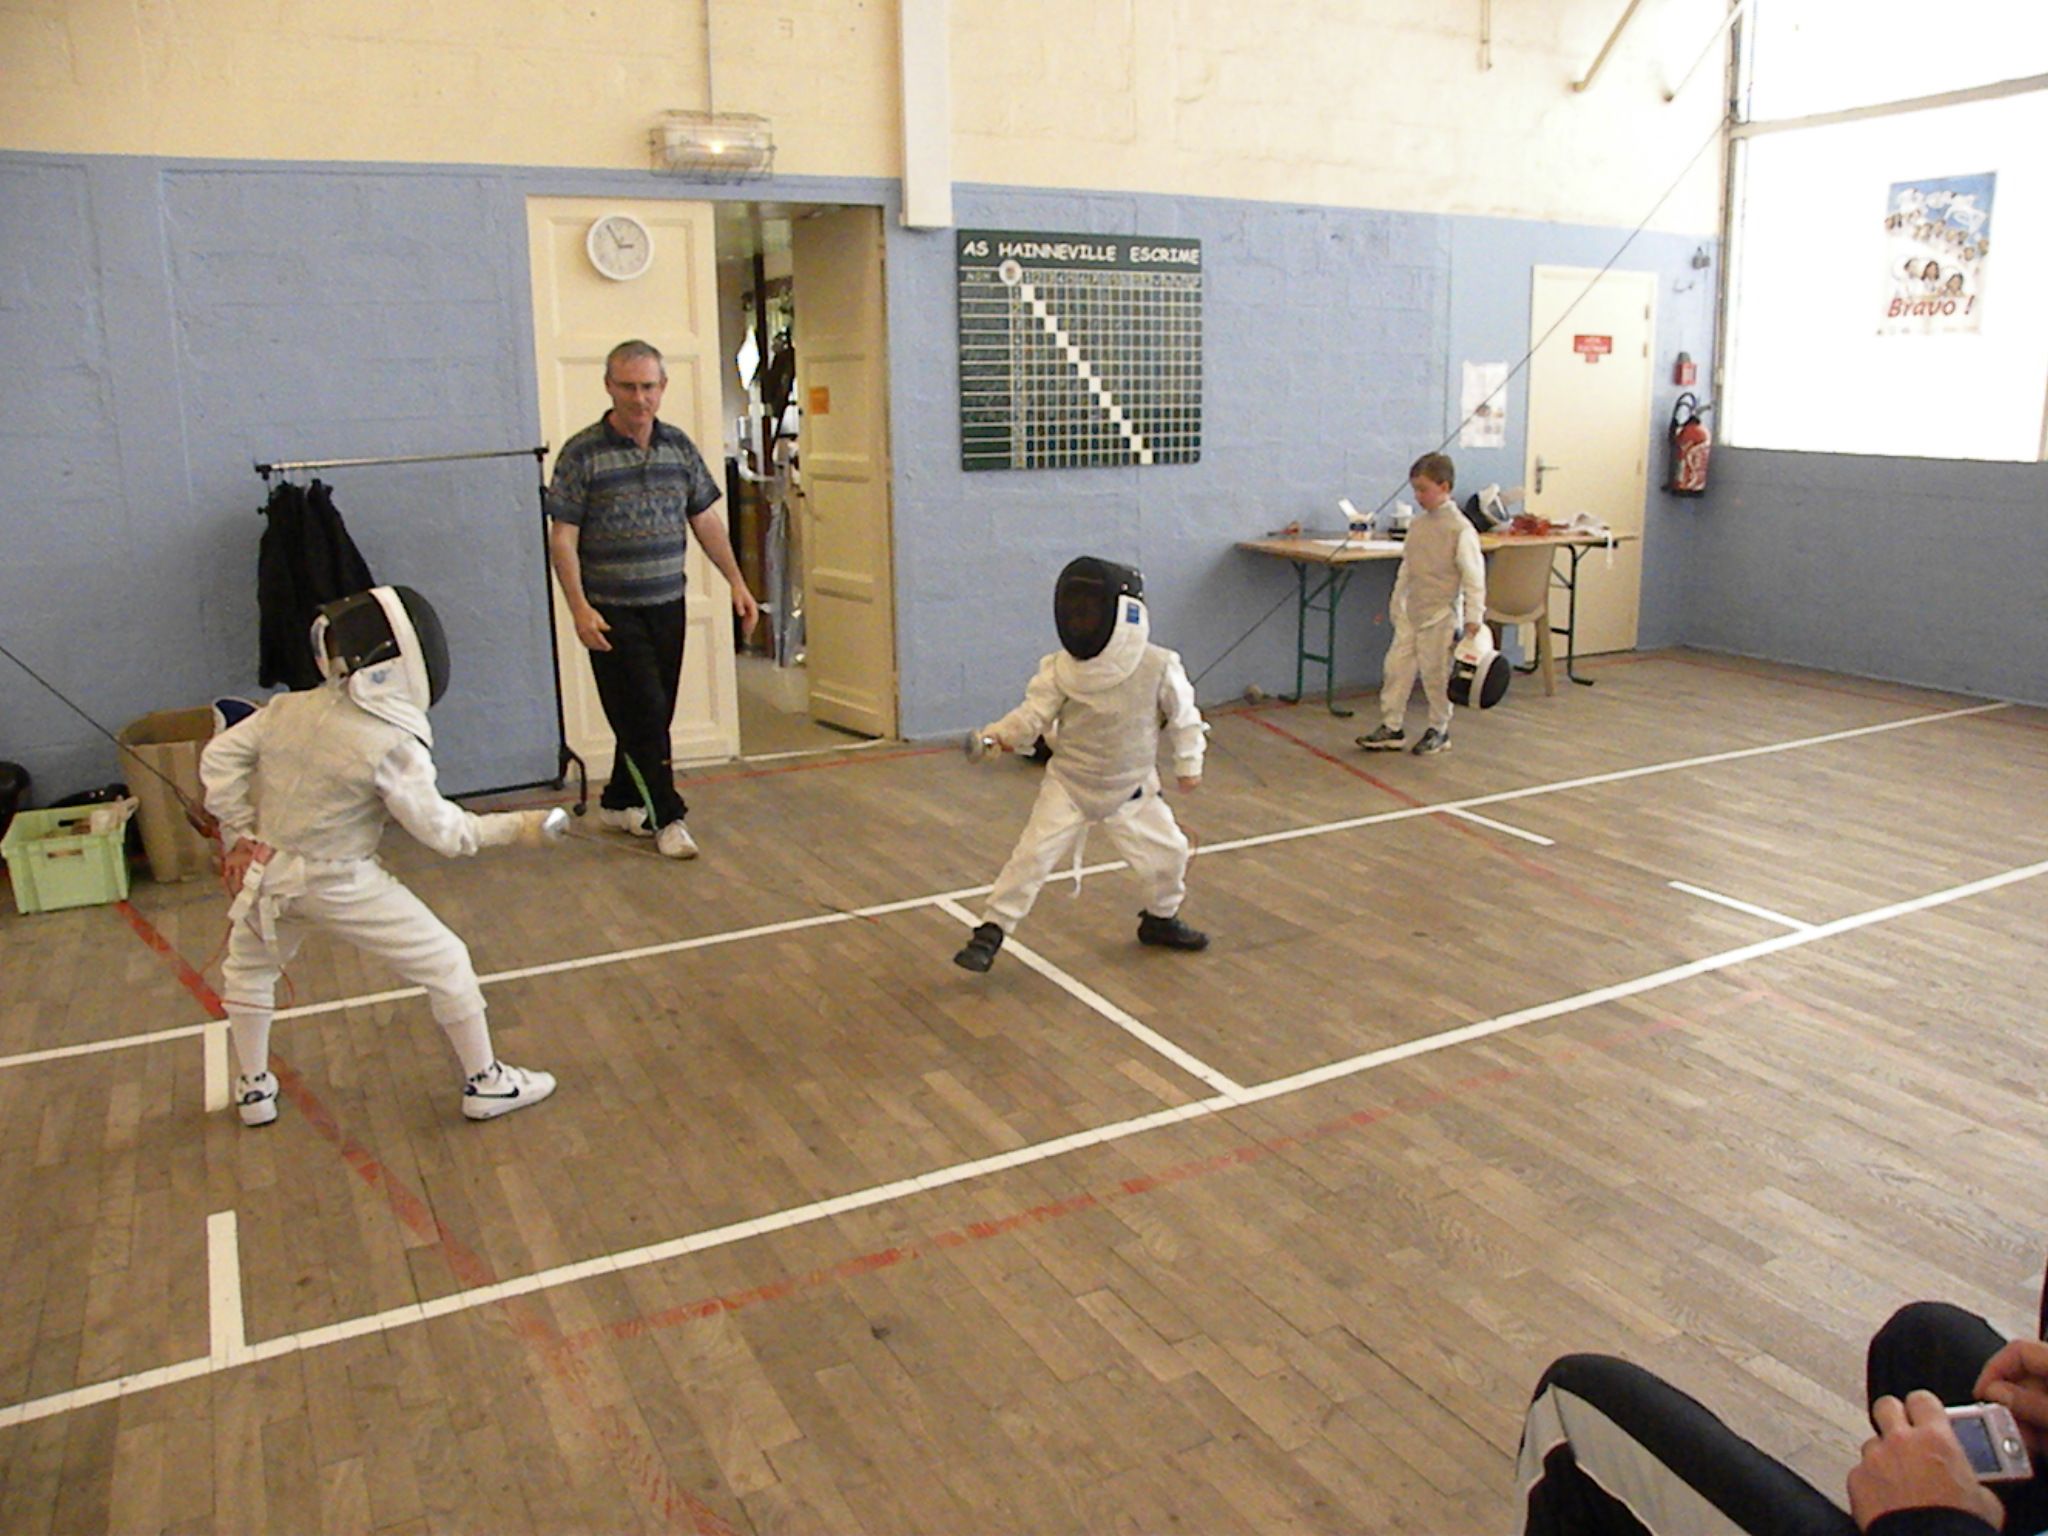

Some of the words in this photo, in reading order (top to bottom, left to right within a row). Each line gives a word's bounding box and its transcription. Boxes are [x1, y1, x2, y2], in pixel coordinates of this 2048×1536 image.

[963, 240, 990, 257] AS
[998, 241, 1118, 263] HAINNEVILLE
[1129, 245, 1200, 266] ESCRIME
[1888, 298, 1956, 317] Bravo
